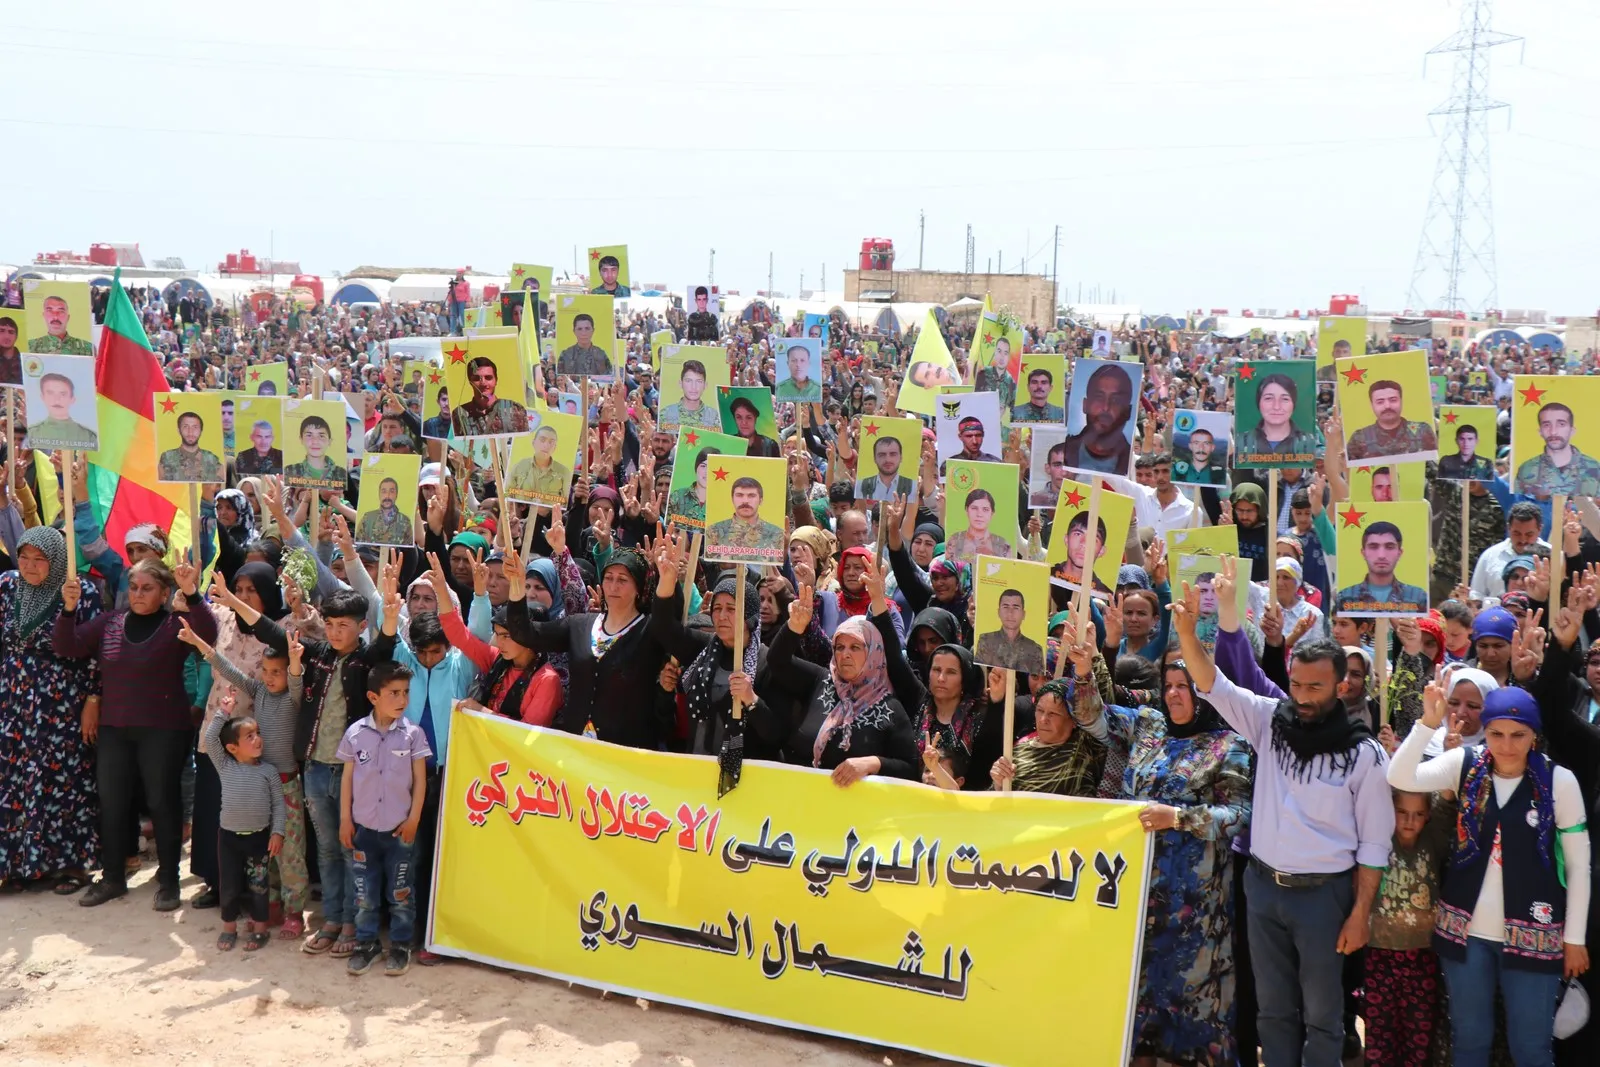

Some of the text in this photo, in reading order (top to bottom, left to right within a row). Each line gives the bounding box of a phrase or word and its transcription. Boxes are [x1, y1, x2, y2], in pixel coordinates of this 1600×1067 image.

[707, 544, 729, 556] ŞEHİD
[730, 545, 759, 555] ARARAT
[465, 760, 573, 826] التركي
[721, 816, 797, 871] على
[800, 826, 940, 898] الدولي
[946, 843, 1085, 901] للصمت
[1093, 849, 1128, 910] لا
